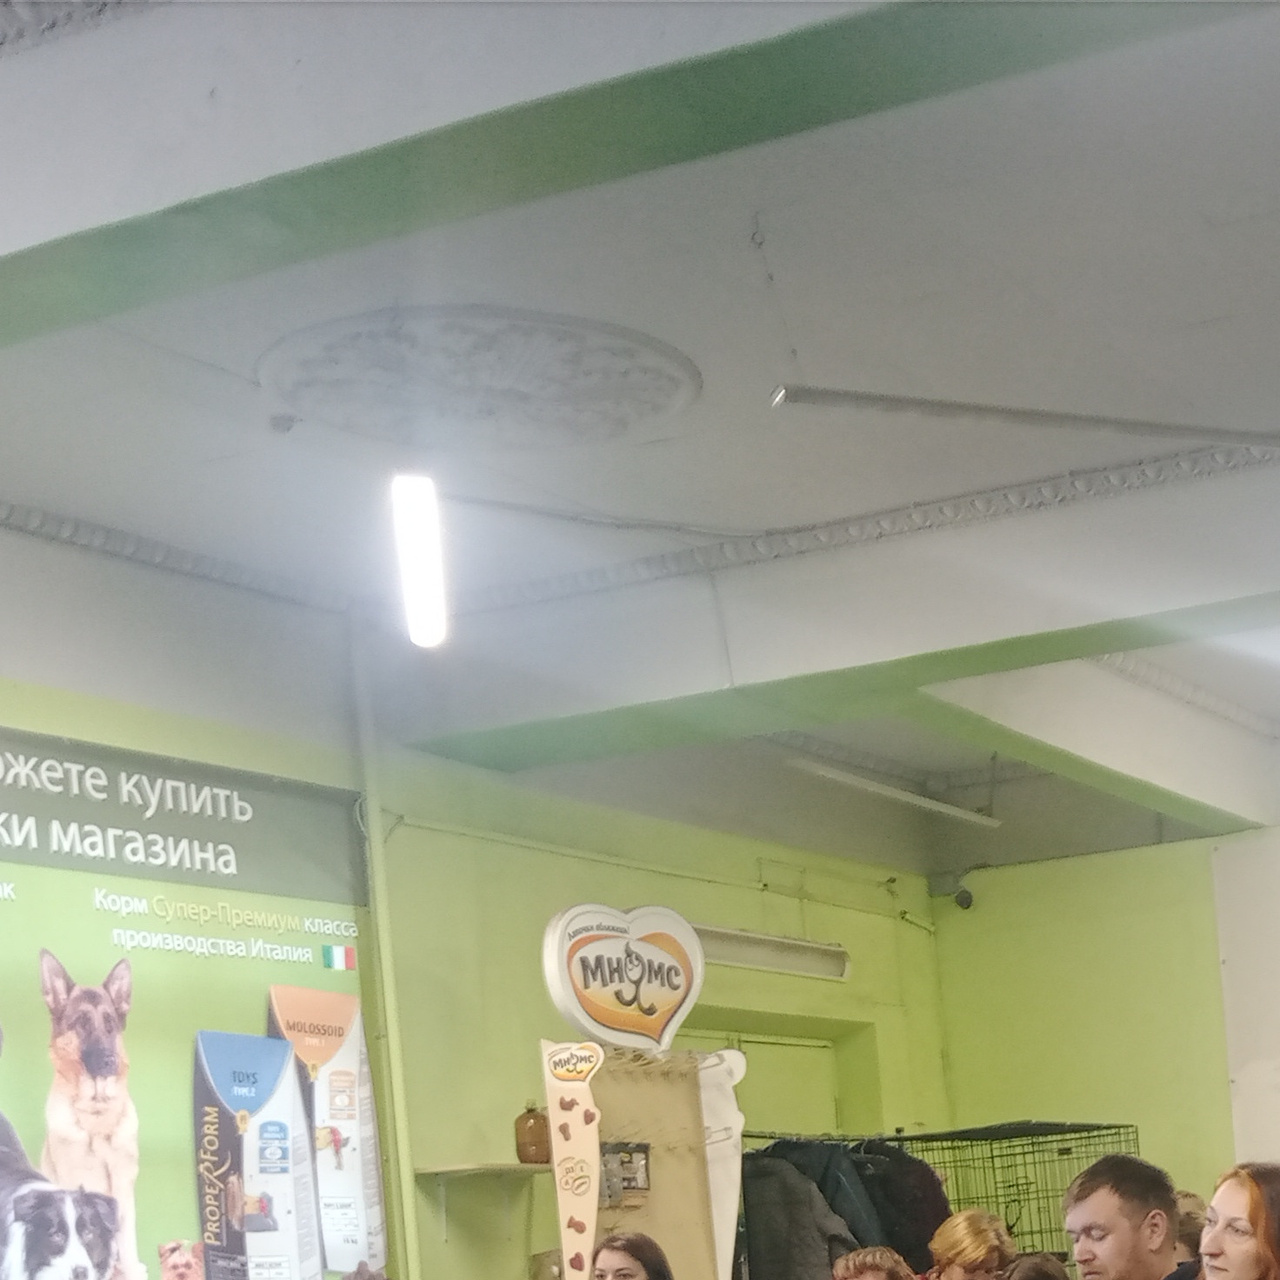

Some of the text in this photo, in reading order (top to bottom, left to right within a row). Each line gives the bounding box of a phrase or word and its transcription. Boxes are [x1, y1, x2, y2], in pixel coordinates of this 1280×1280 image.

[0, 751, 253, 822] жете купить
[51, 820, 237, 874] магазина
[94, 887, 358, 937] Корм Супер-Премиум класса
[112, 927, 312, 963] производства Италия
[286, 1019, 345, 1038] MOLOSSOID
[232, 1070, 258, 1085] TOYS
